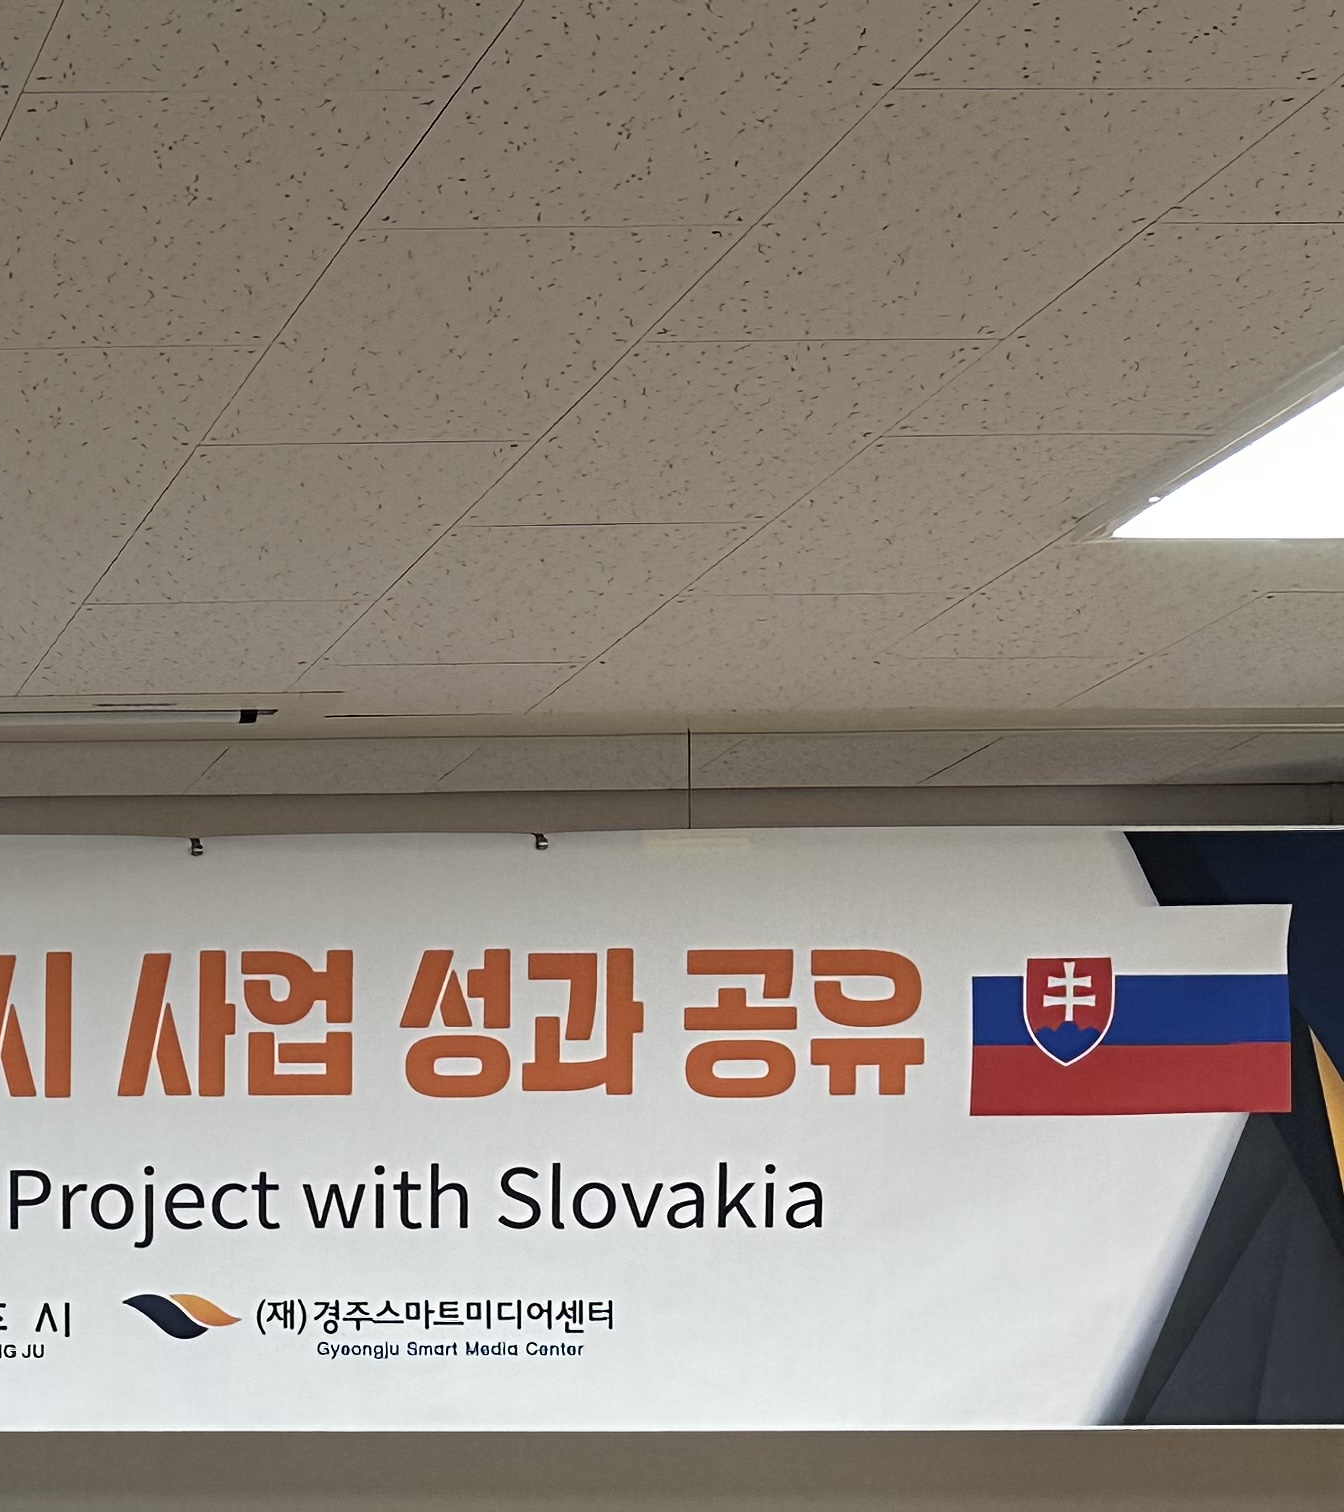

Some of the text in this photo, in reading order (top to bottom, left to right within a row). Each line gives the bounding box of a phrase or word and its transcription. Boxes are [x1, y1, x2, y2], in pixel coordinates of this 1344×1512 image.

[117, 949, 354, 1098] 사업
[399, 947, 645, 1099] 성과
[683, 948, 926, 1099] 공유
[9, 1165, 281, 1249] Project
[302, 1162, 469, 1230] with
[497, 1161, 823, 1230] Slovakia
[21, 1344, 45, 1359] JU
[316, 1340, 585, 1360] Gyeongju Smart Media Center
